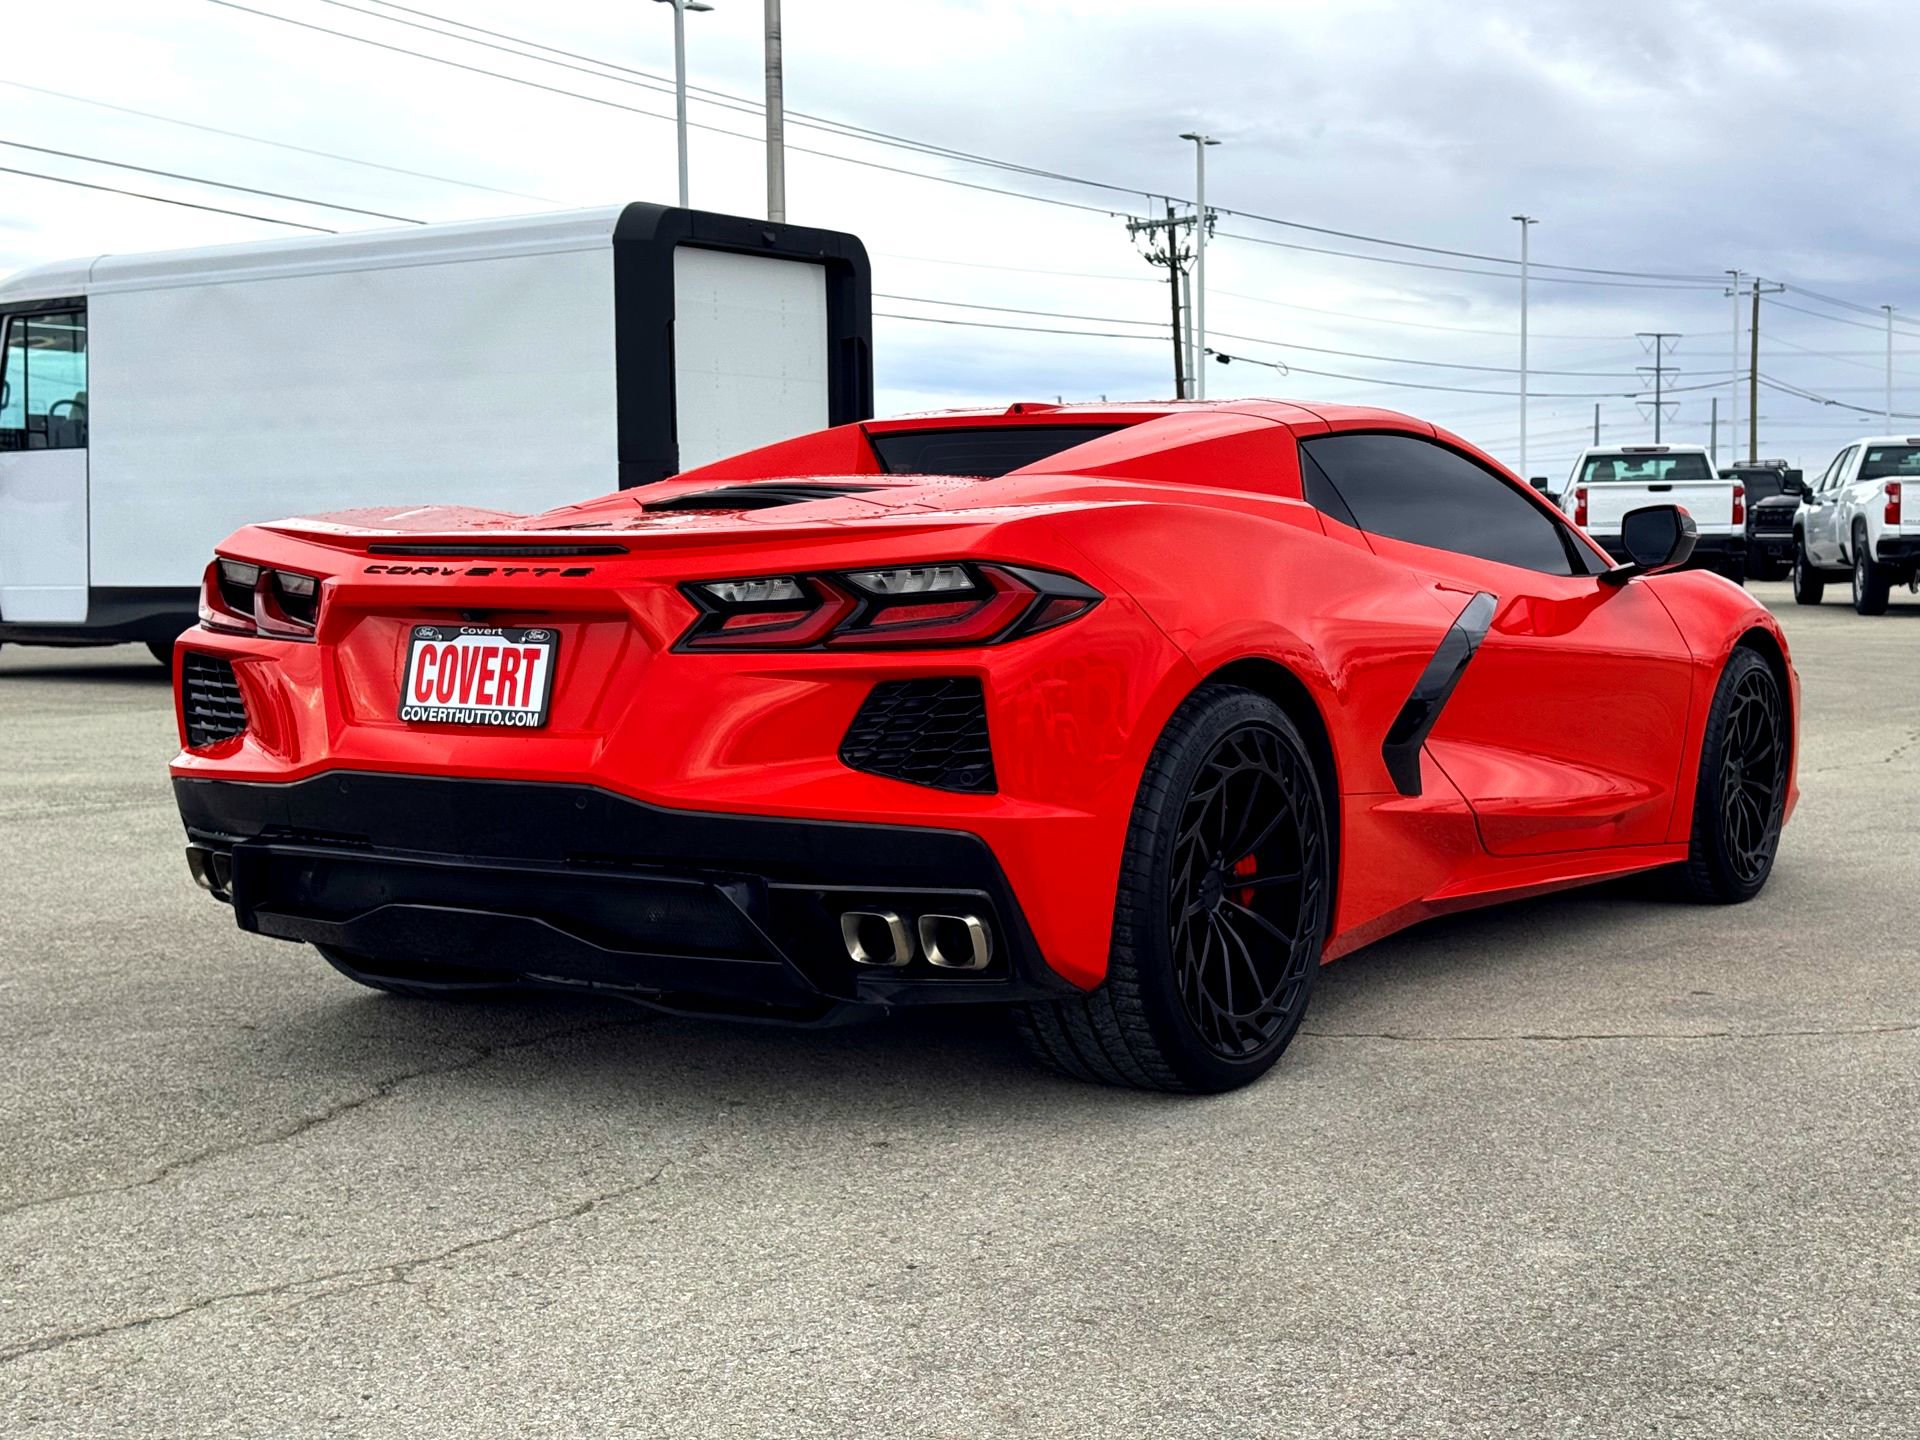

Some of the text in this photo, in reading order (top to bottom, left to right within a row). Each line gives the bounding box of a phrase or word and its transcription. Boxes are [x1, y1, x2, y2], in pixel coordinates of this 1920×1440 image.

[364, 565, 595, 577] CORVETTE
[460, 626, 503, 635] Covert
[414, 643, 542, 707] COVERT
[401, 706, 539, 727] COVERTHUTTO.COM
